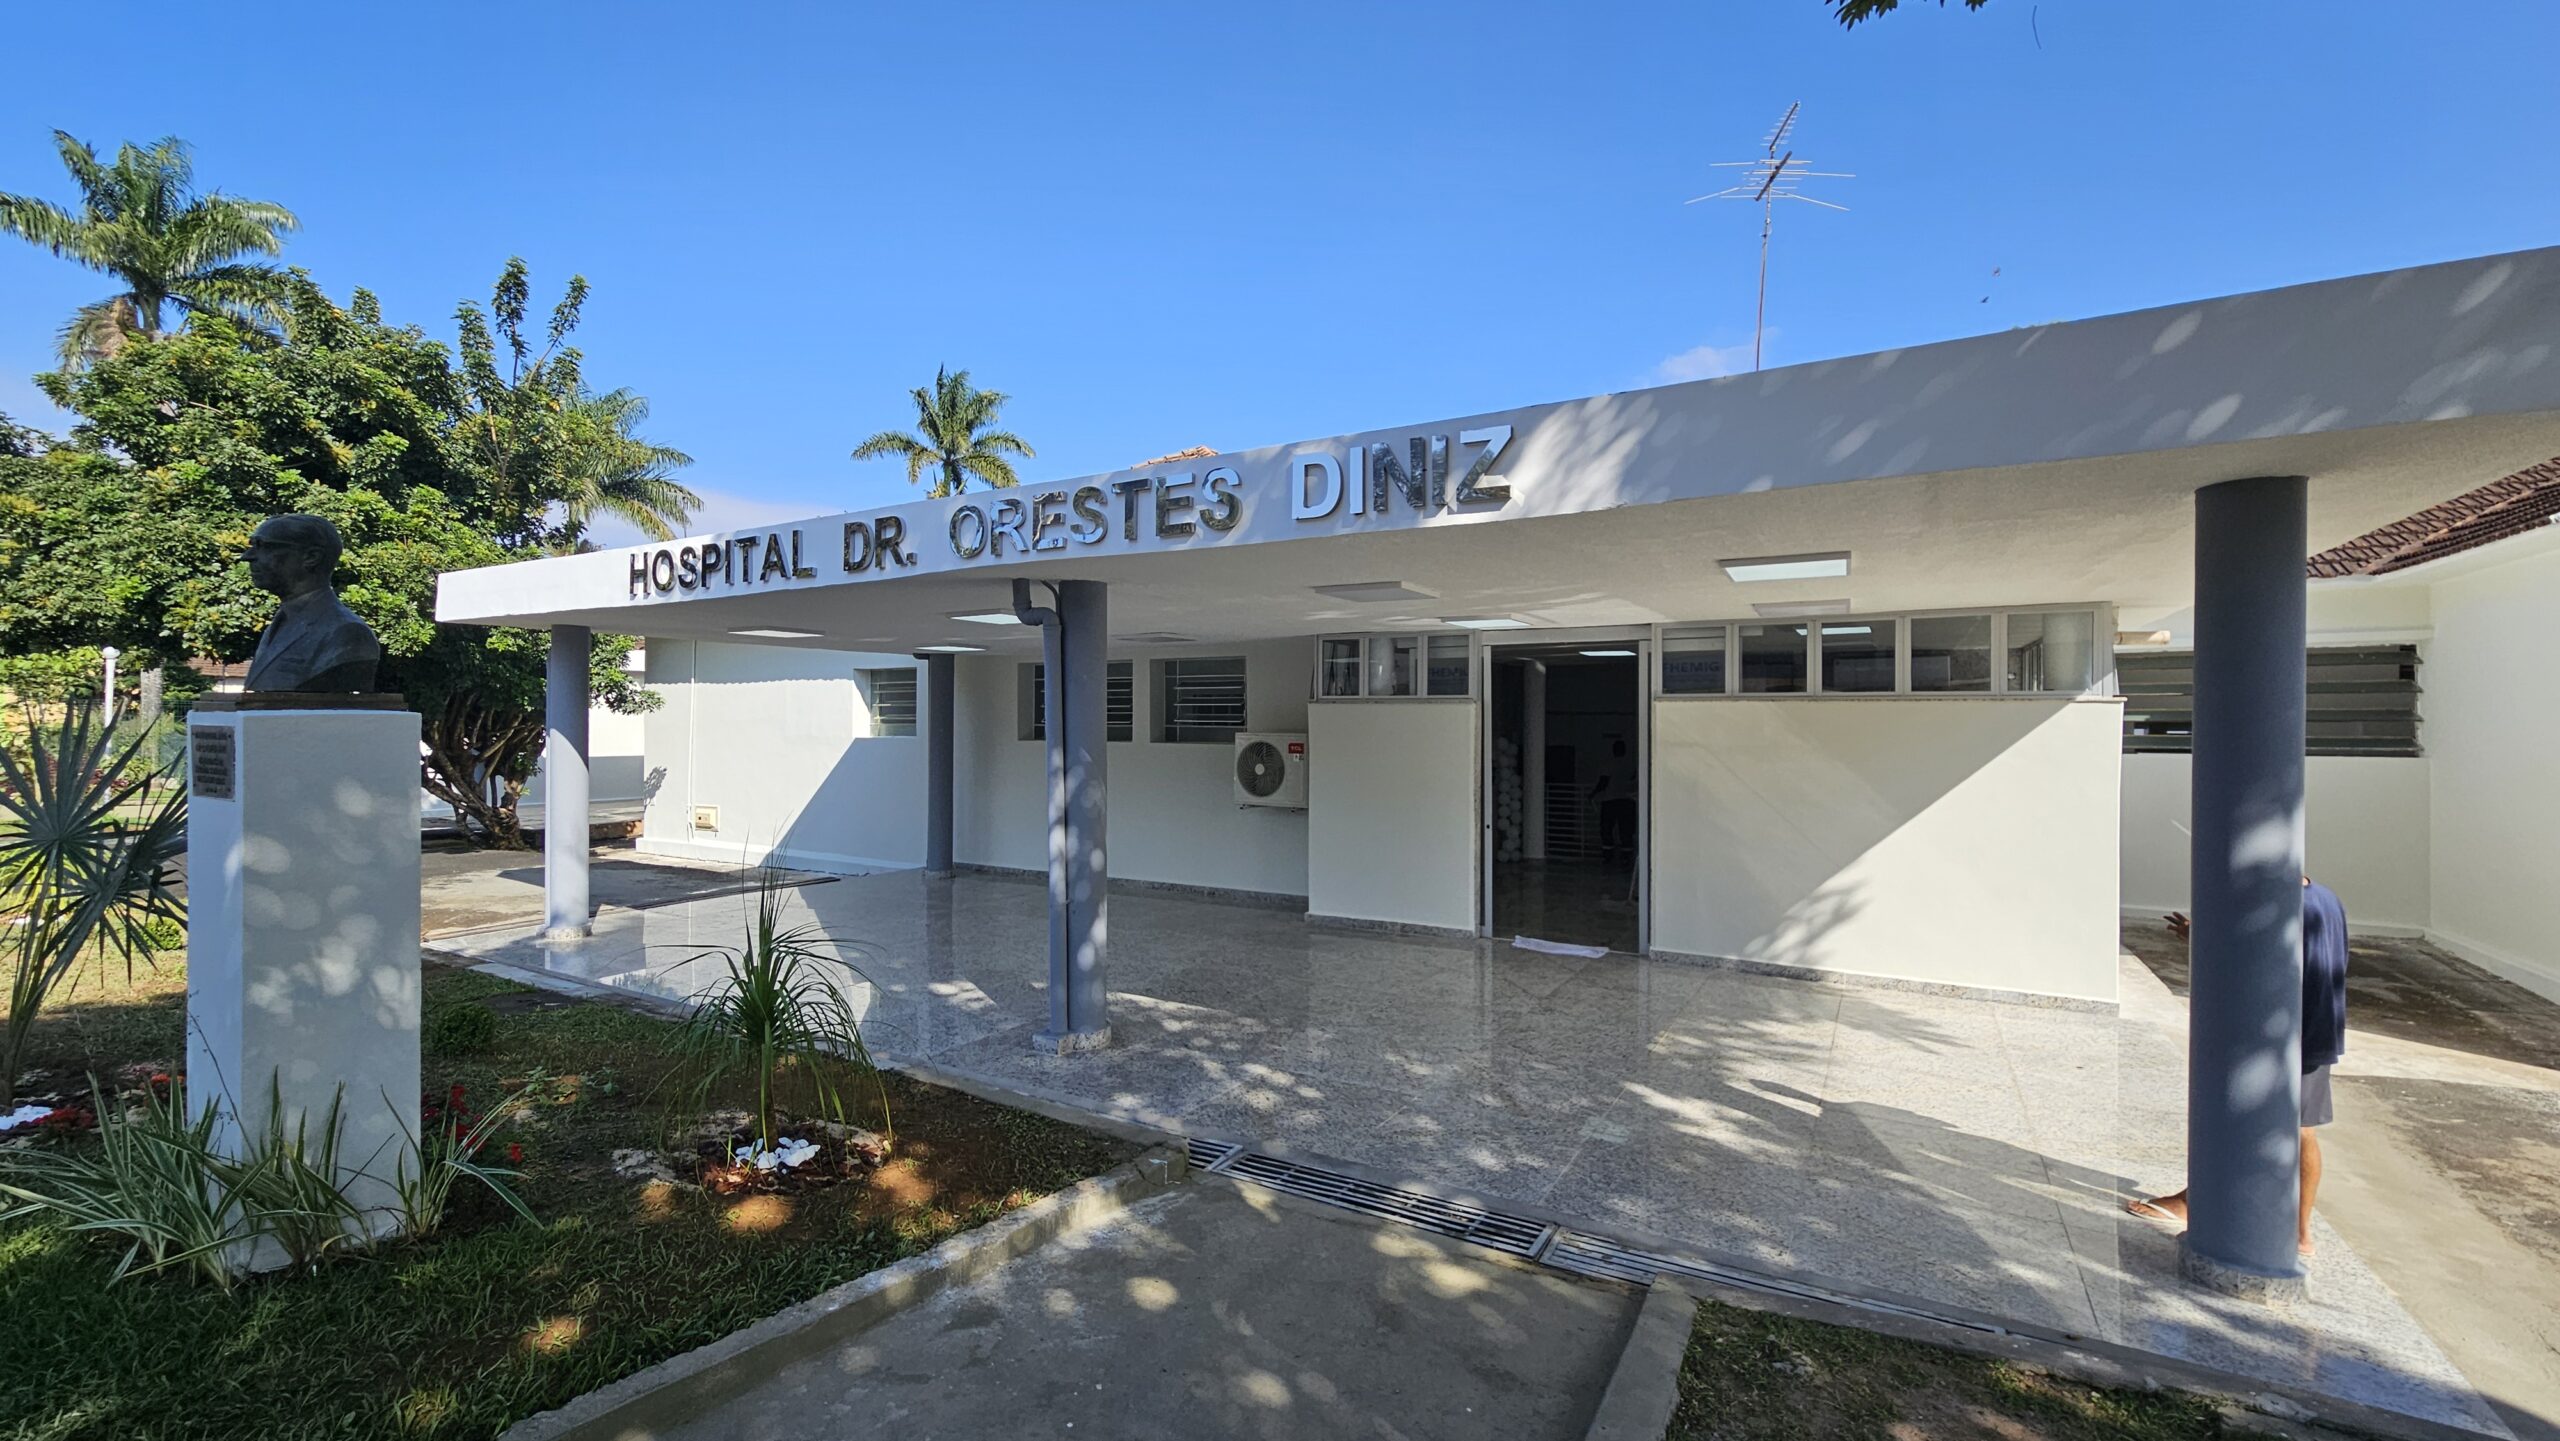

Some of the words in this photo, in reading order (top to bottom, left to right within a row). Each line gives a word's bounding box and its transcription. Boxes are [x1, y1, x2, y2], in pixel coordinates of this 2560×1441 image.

[630, 529, 817, 596] HOSPITAL
[843, 515, 917, 572] DR.
[950, 466, 1242, 559] ORESTES
[1291, 424, 1513, 520] DINIZ
